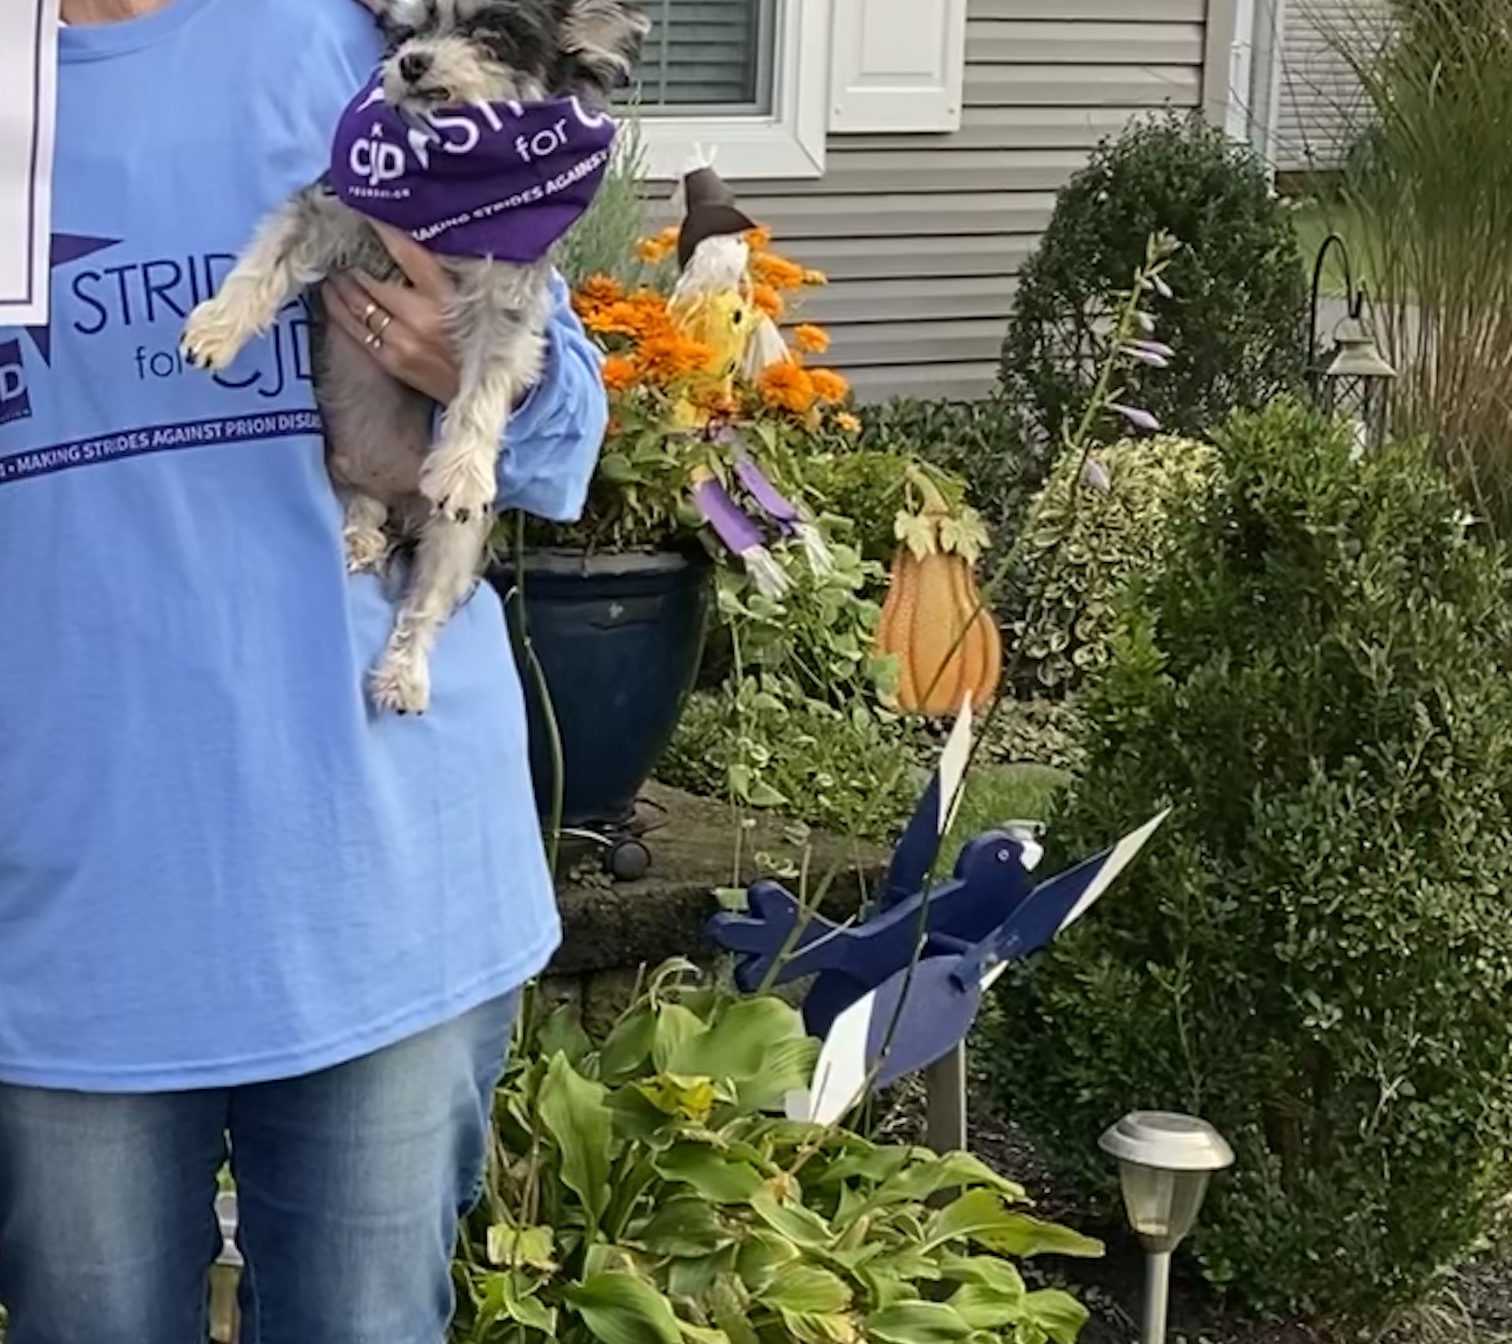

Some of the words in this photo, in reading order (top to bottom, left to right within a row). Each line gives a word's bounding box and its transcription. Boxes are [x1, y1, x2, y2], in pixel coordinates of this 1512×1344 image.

[515, 118, 567, 162] for
[16, 444, 81, 474] MAKING
[83, 432, 150, 459] STRIDES
[151, 423, 223, 447] AGAINST
[224, 415, 277, 437] PRION
